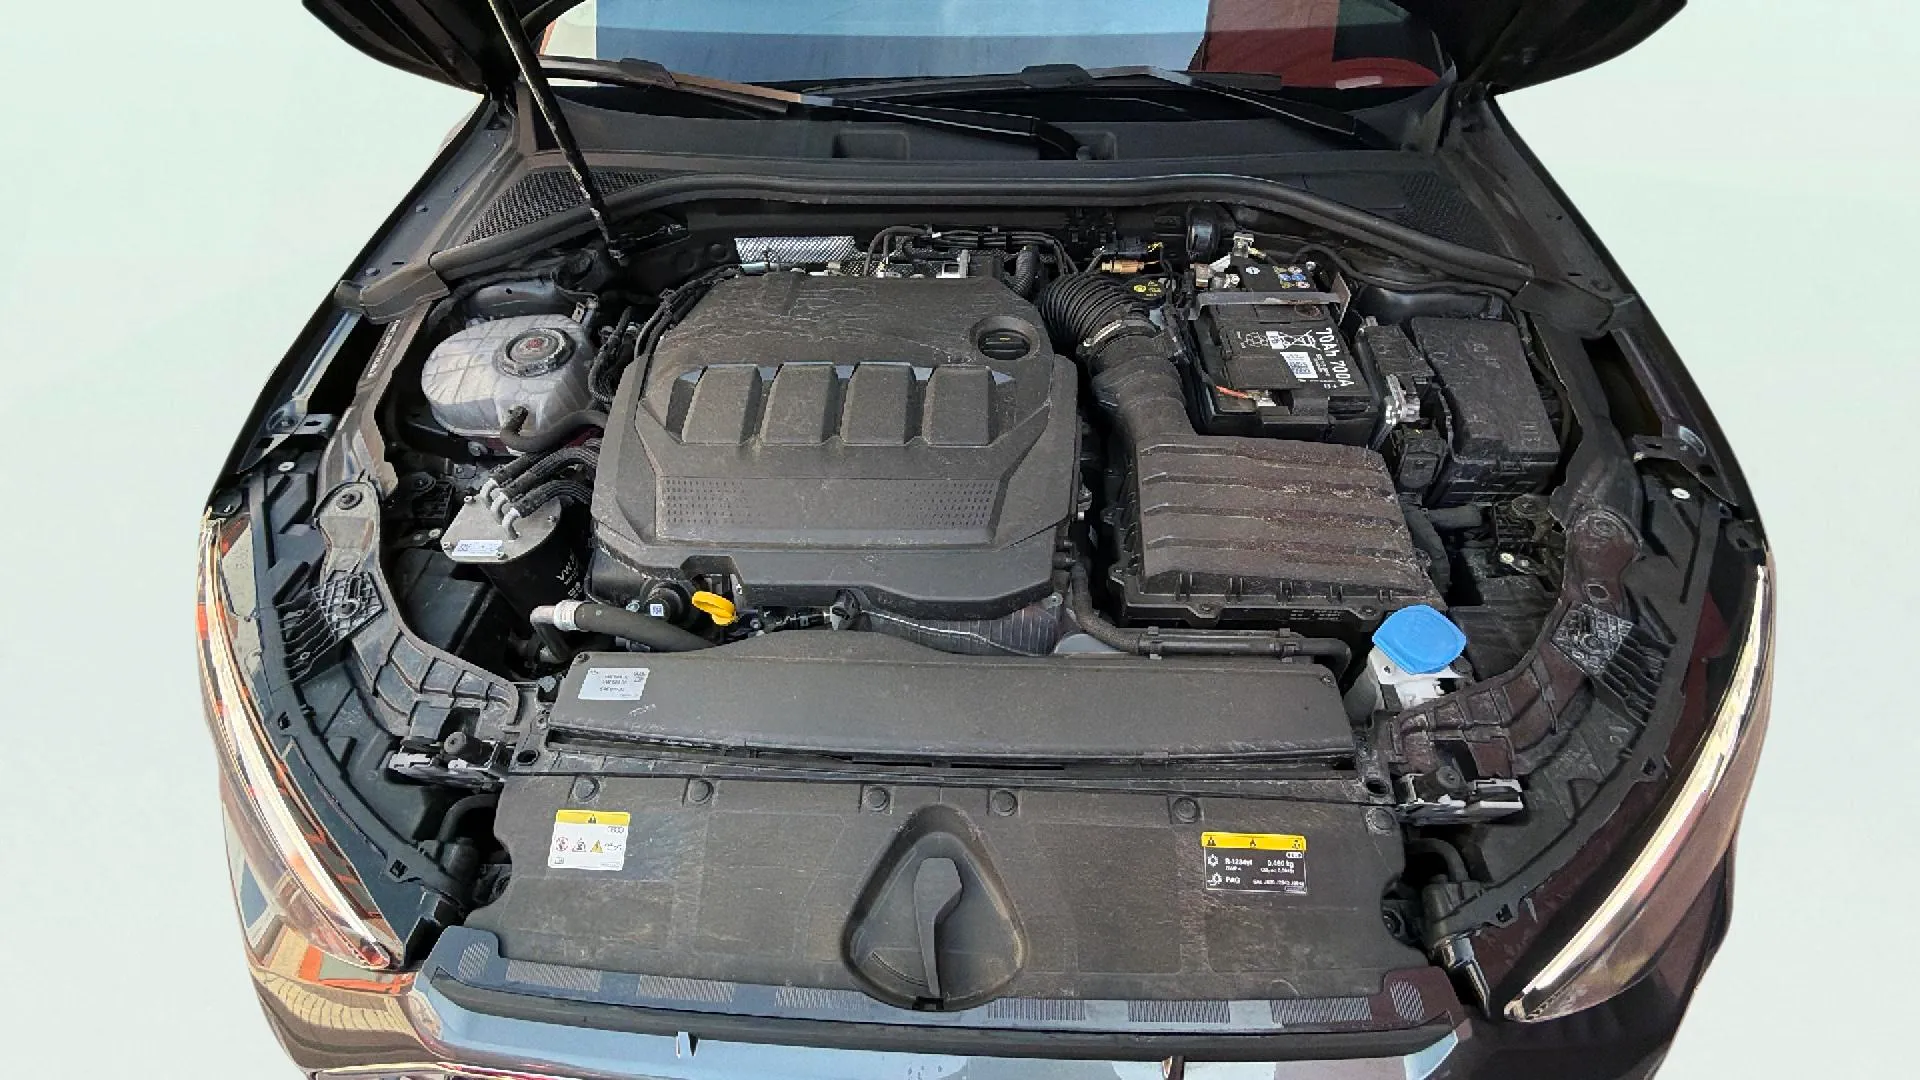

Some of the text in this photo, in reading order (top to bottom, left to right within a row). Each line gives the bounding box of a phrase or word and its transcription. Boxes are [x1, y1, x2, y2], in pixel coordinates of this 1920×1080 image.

[1315, 327, 1340, 357] 70Ah
[1330, 360, 1355, 387] 700A
[1285, 859, 1295, 869] kg
